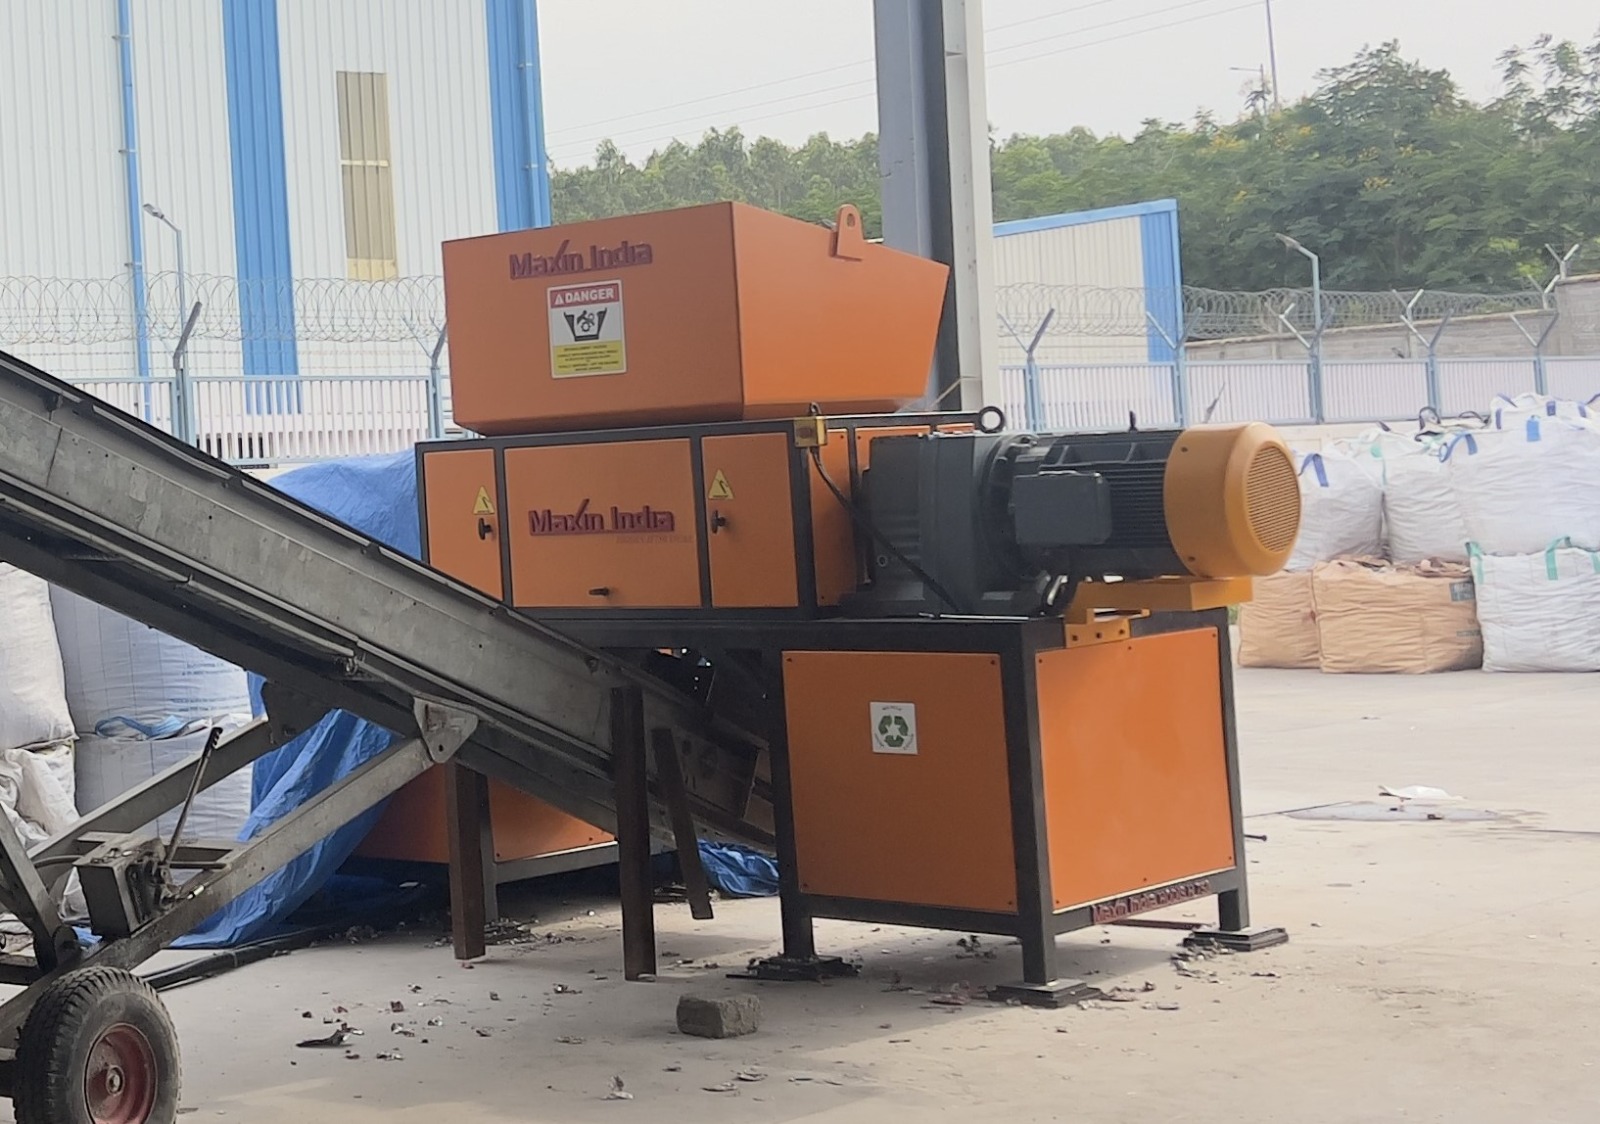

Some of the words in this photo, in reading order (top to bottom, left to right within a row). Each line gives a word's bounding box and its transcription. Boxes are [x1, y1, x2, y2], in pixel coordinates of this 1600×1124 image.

[509, 240, 584, 279] Maxin
[589, 241, 653, 269] India
[564, 287, 614, 303] DANGER
[528, 498, 604, 535] Maxin
[610, 504, 675, 533] India
